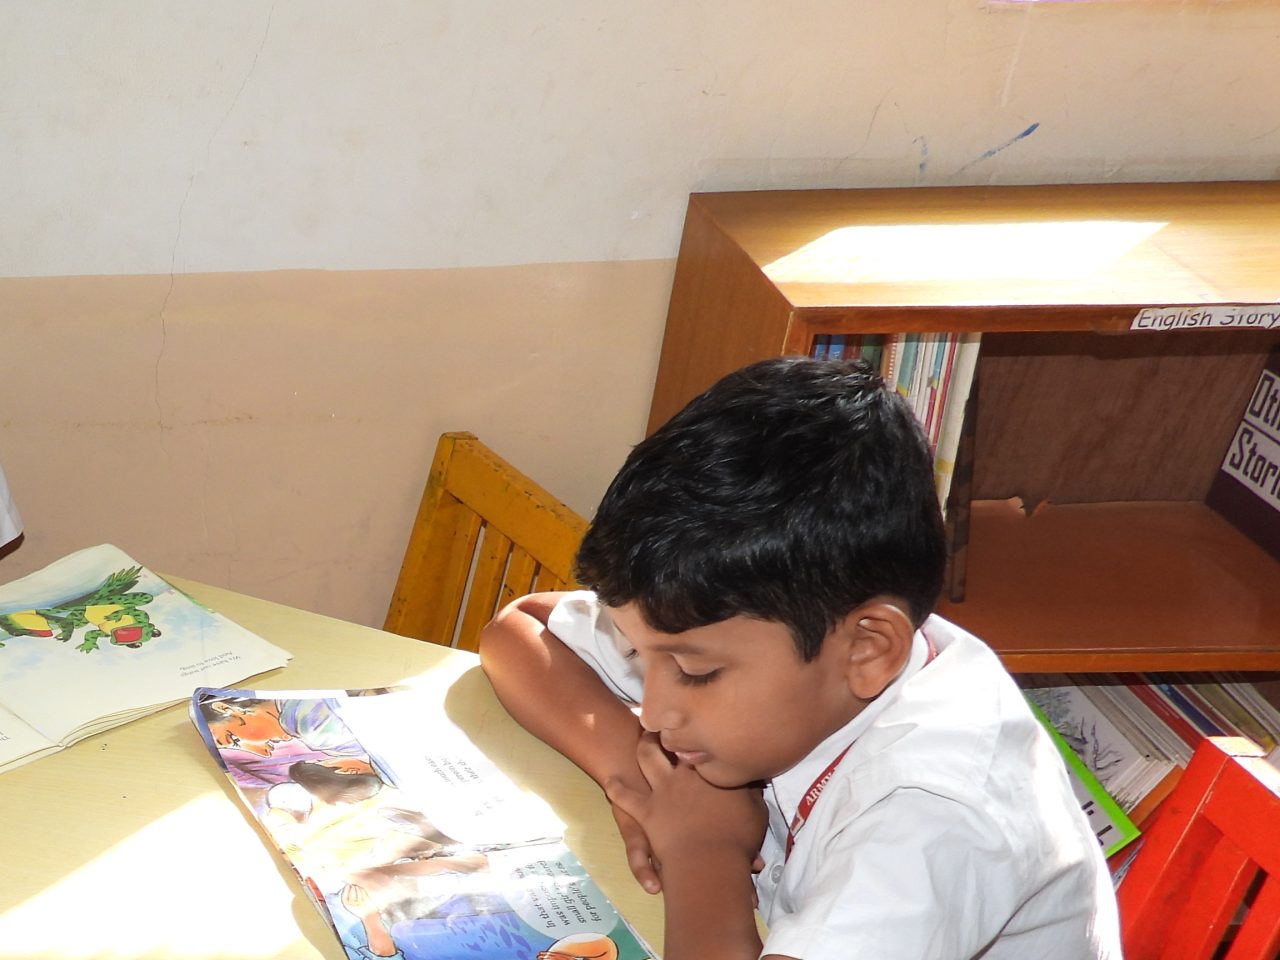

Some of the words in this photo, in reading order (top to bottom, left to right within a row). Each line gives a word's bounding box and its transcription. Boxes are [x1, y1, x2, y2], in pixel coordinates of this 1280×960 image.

[1138, 309, 1212, 330] English
[569, 882, 597, 910] people's
[534, 904, 550, 919] that
[556, 911, 571, 926] was
[567, 905, 587, 924] small
[590, 911, 602, 922] for
[546, 920, 557, 928] In
